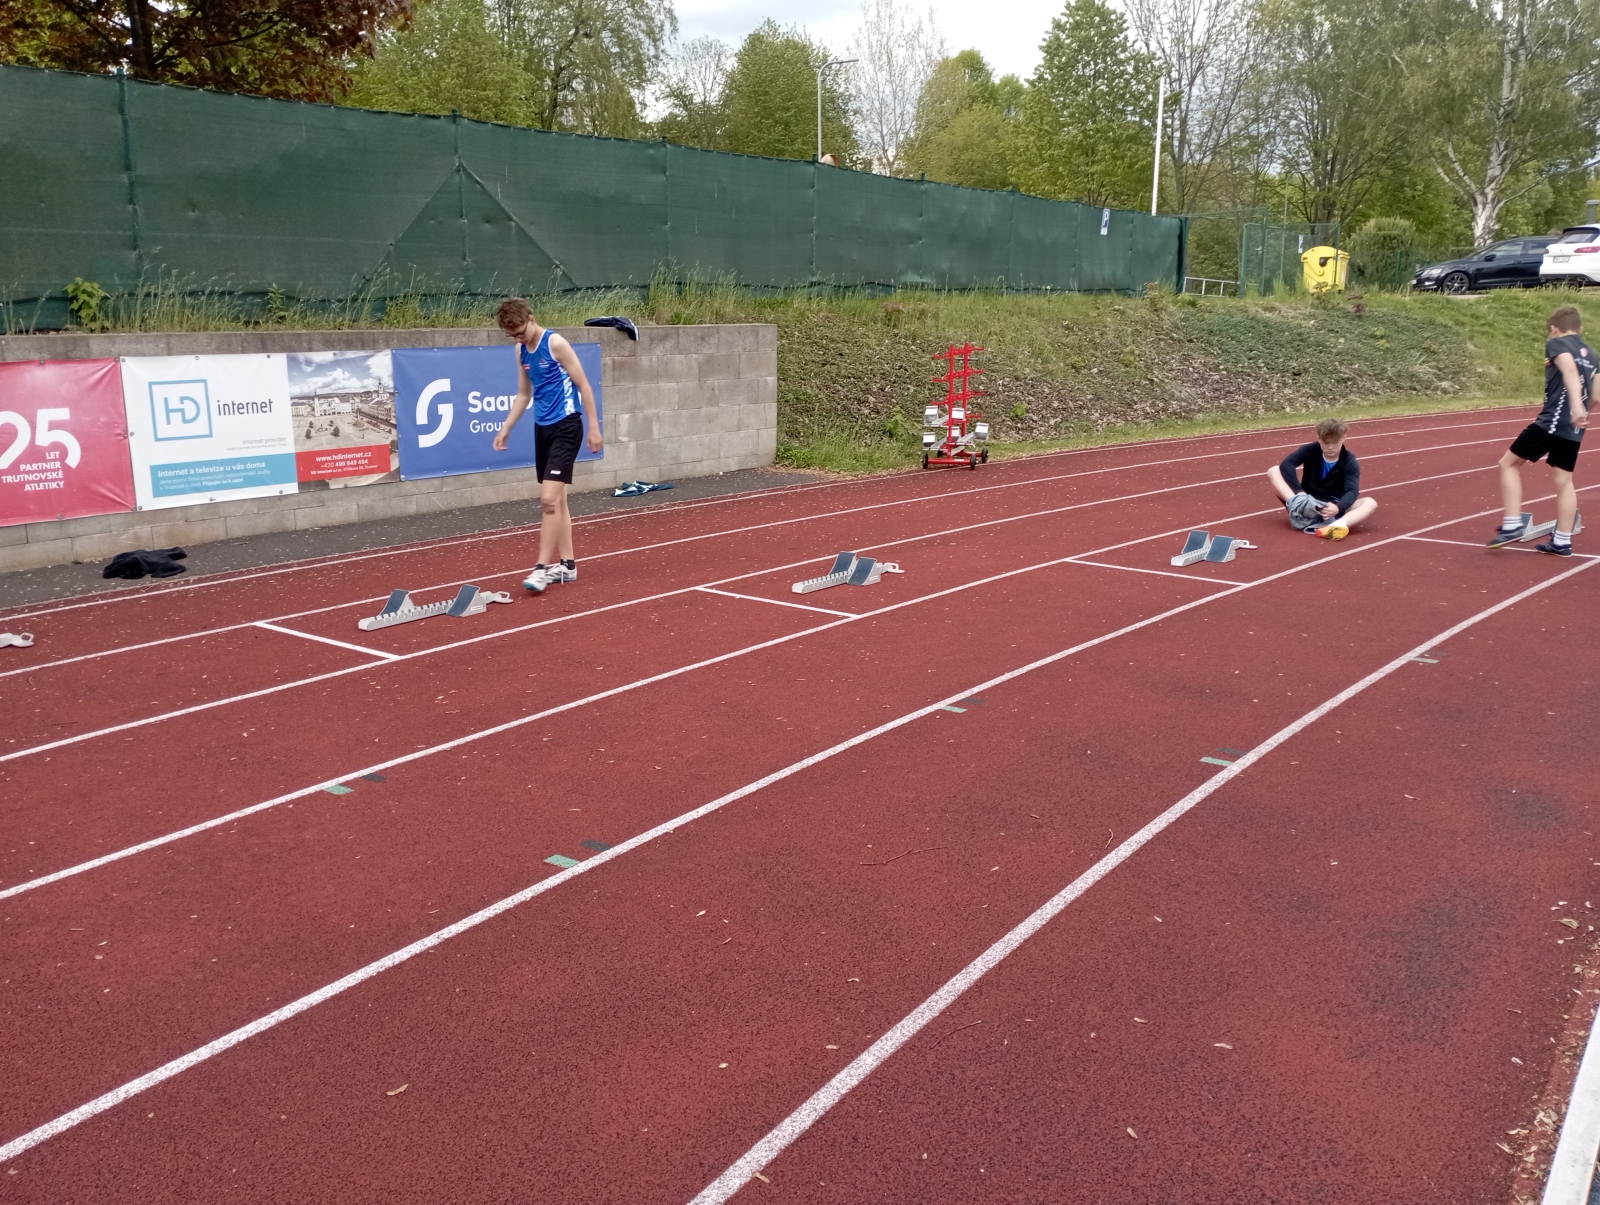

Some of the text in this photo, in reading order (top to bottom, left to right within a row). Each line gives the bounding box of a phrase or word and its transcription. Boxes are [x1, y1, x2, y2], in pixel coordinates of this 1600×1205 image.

[163, 395, 274, 426] HD internet
[469, 419, 508, 434] Grou
[45, 451, 60, 460] LET
[315, 451, 372, 462] www.hdinternet.cz
[19, 461, 62, 471] PARTNER
[157, 468, 188, 478] Internet
[195, 464, 224, 474] televize
[231, 462, 245, 470] vás
[245, 461, 266, 469] doma
[1, 469, 64, 483] TRUTNOVSKÉ
[24, 480, 65, 492] ATLETIKY
